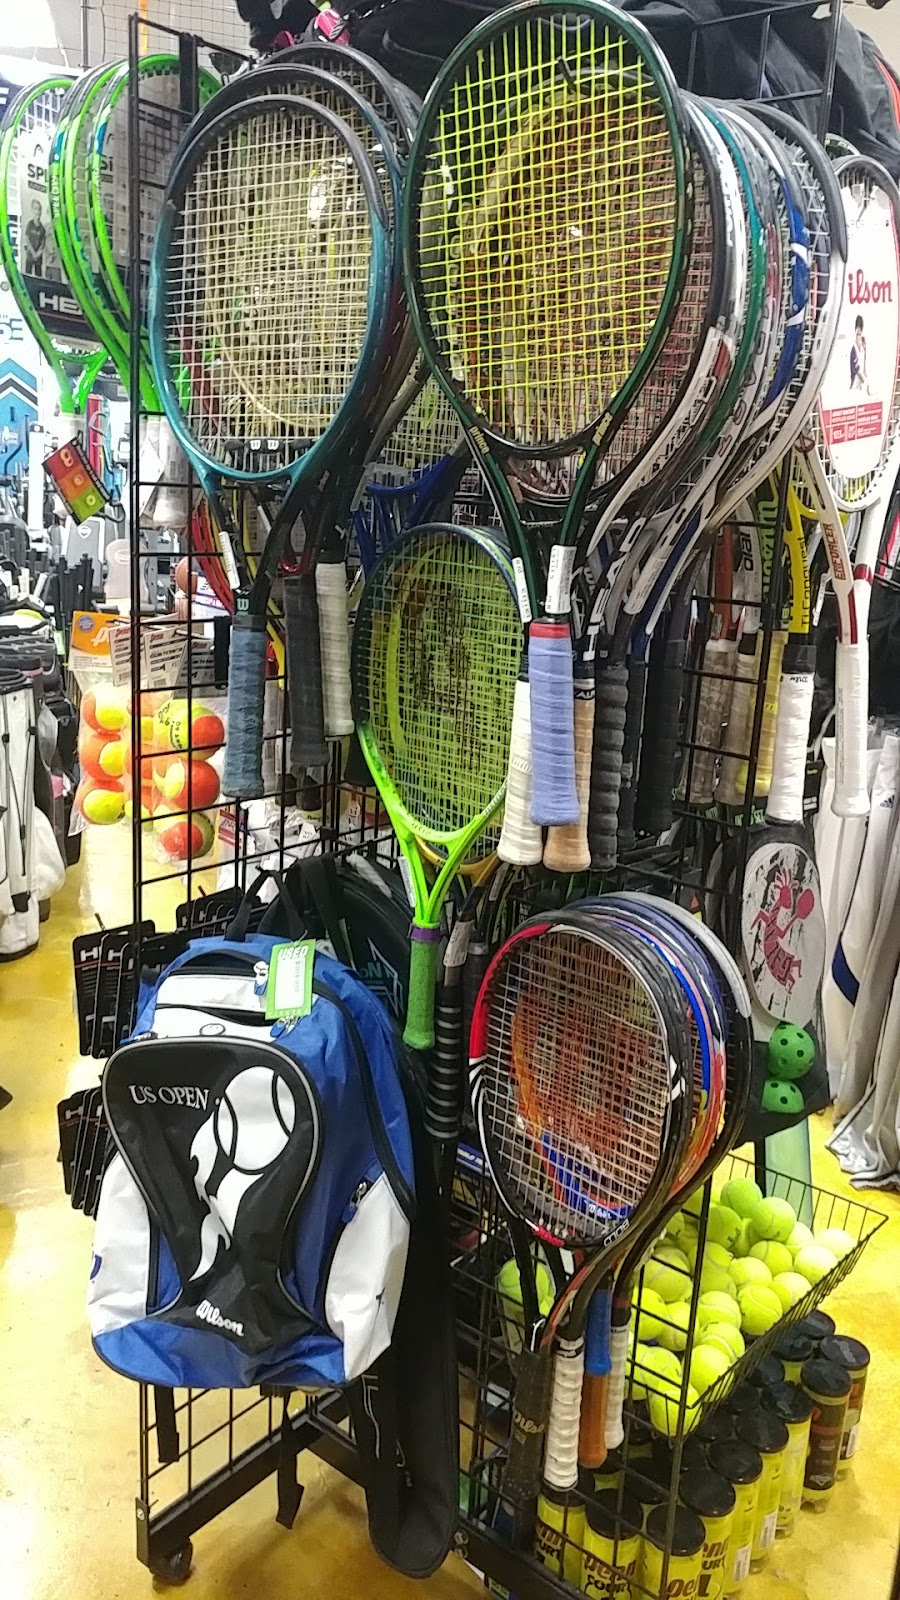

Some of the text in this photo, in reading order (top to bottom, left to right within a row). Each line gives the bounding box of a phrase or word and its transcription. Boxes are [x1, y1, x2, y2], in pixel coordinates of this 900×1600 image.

[848, 268, 893, 304] ilson
[39, 291, 84, 316] HE
[823, 523, 847, 581] ENFORCER
[279, 945, 309, 960] USED
[128, 1085, 210, 1112] US OPEN
[195, 1299, 245, 1337] Wilson
